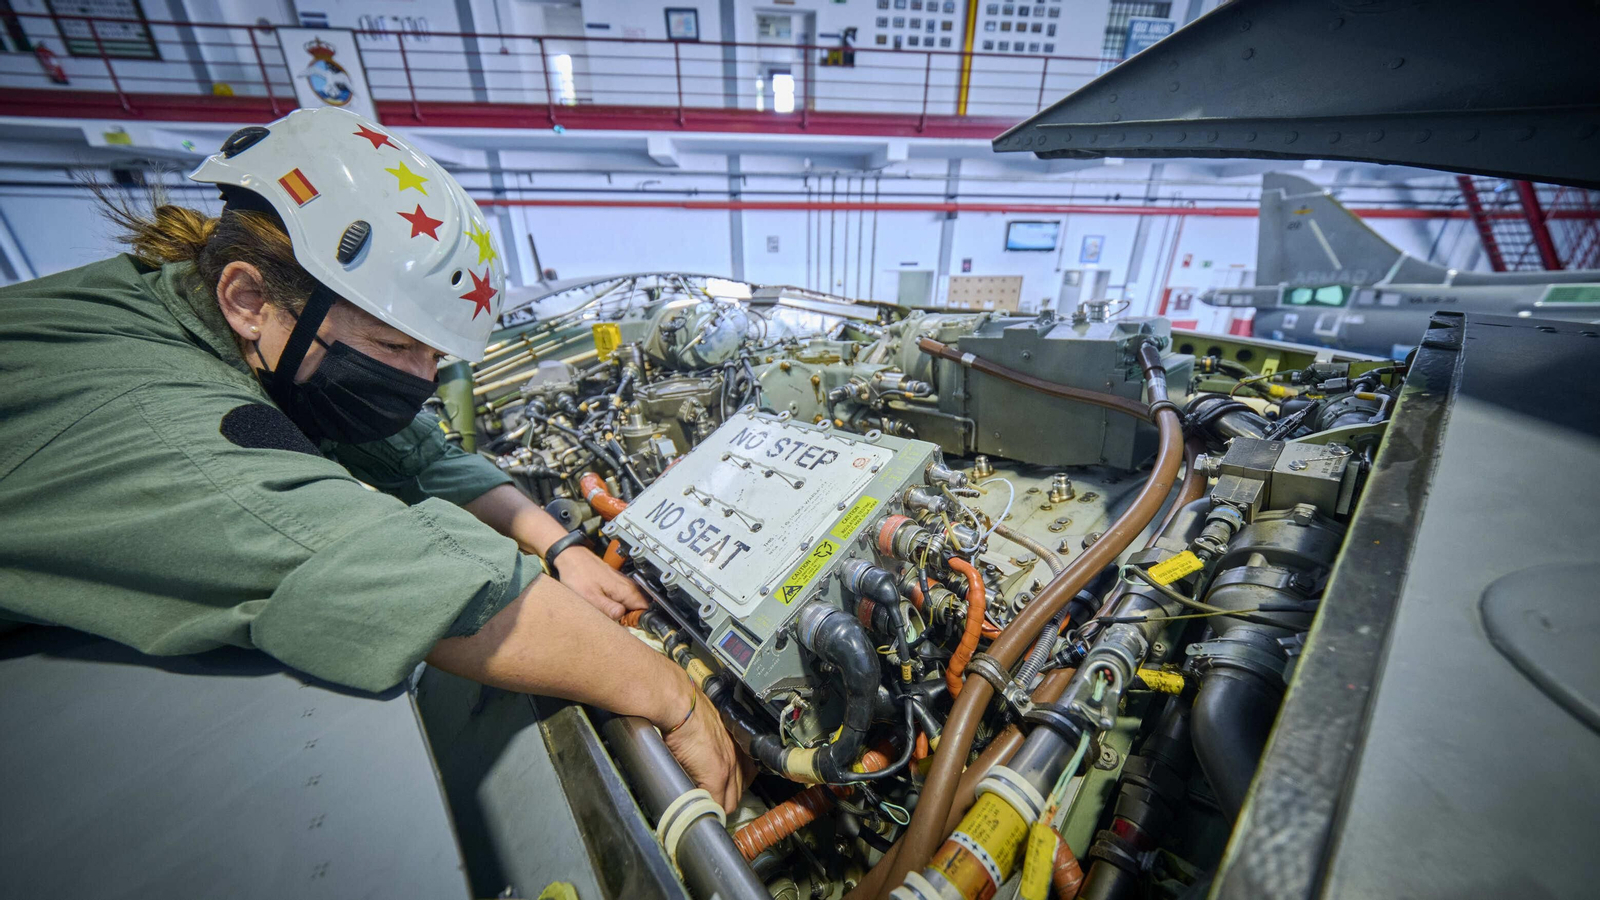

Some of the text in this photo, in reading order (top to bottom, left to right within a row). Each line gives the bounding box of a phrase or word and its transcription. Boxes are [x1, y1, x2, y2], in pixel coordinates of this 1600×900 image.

[729, 427, 768, 448] NO
[766, 437, 839, 472] STEP
[841, 505, 859, 524] CAUTION
[645, 498, 685, 529] NO
[678, 518, 751, 571] SEAT
[791, 559, 811, 580] CAUTION
